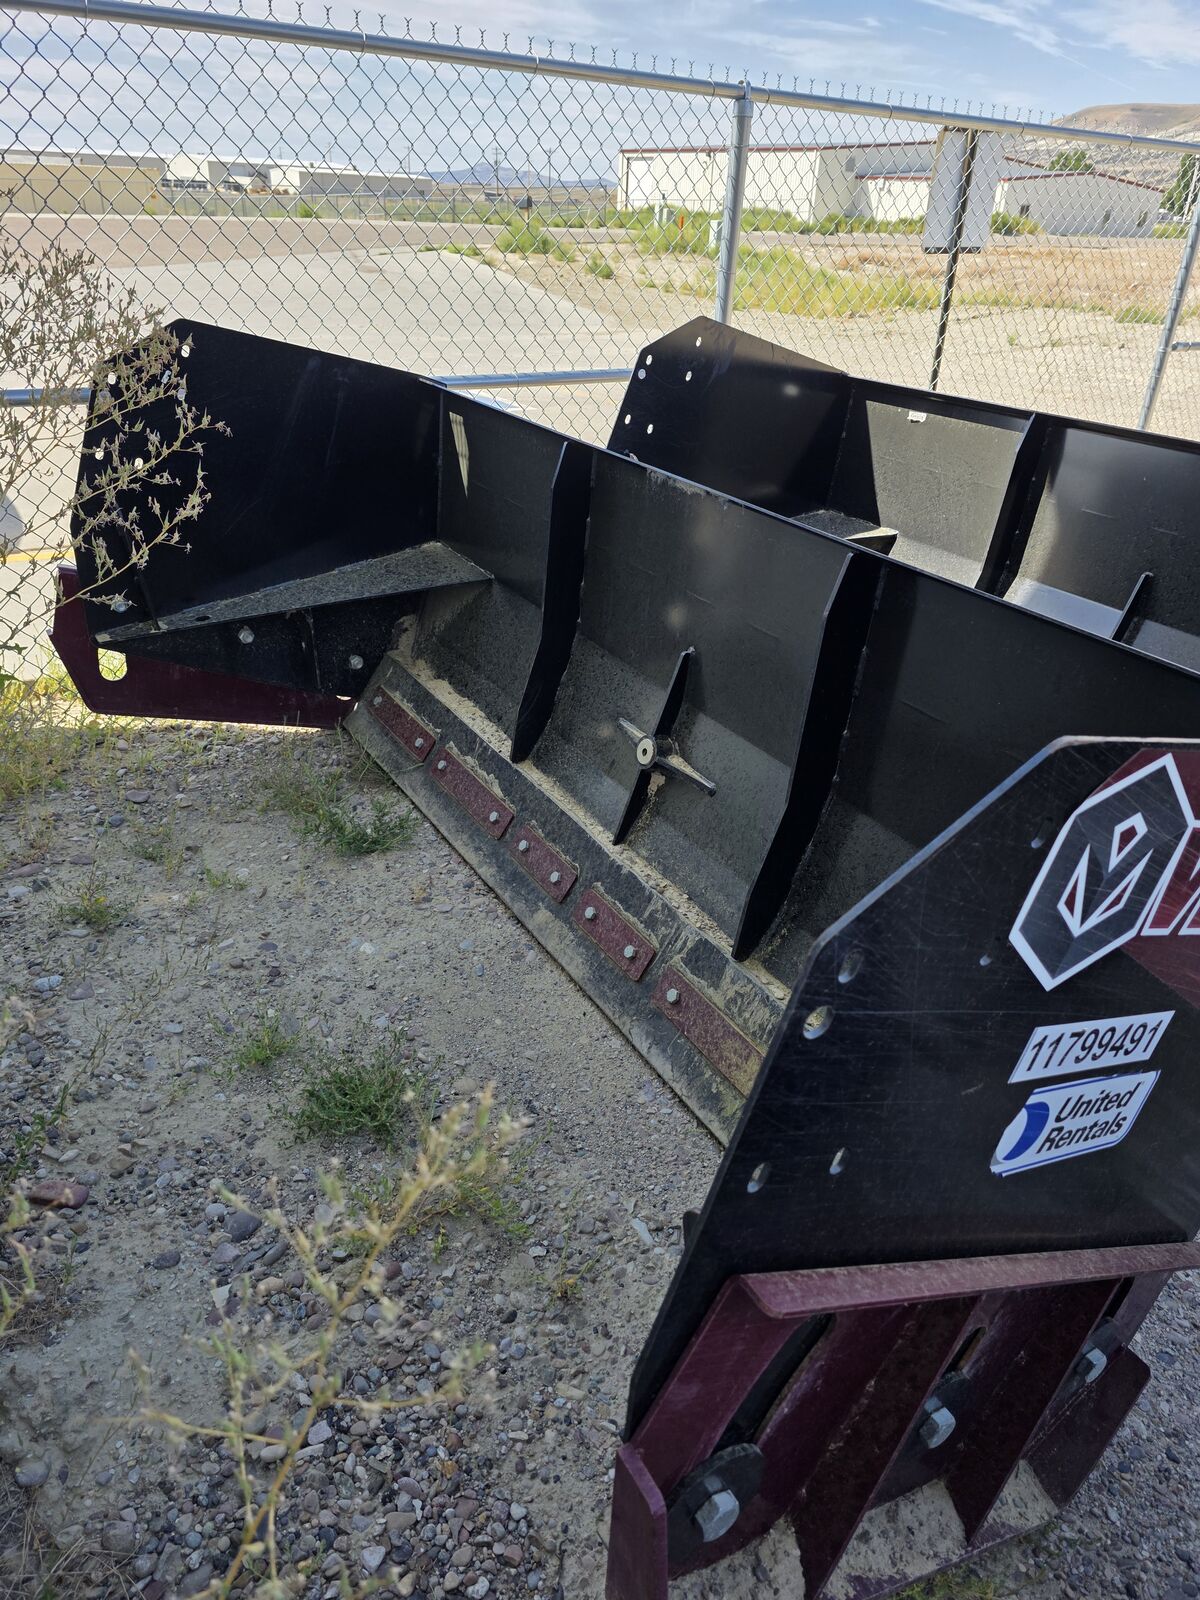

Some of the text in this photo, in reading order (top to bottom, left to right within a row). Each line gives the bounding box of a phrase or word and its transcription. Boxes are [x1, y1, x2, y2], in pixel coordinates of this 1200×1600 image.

[1026, 1020, 1163, 1071] 11799491
[1054, 1082, 1141, 1123] United
[1036, 1112, 1127, 1154] Rentals
